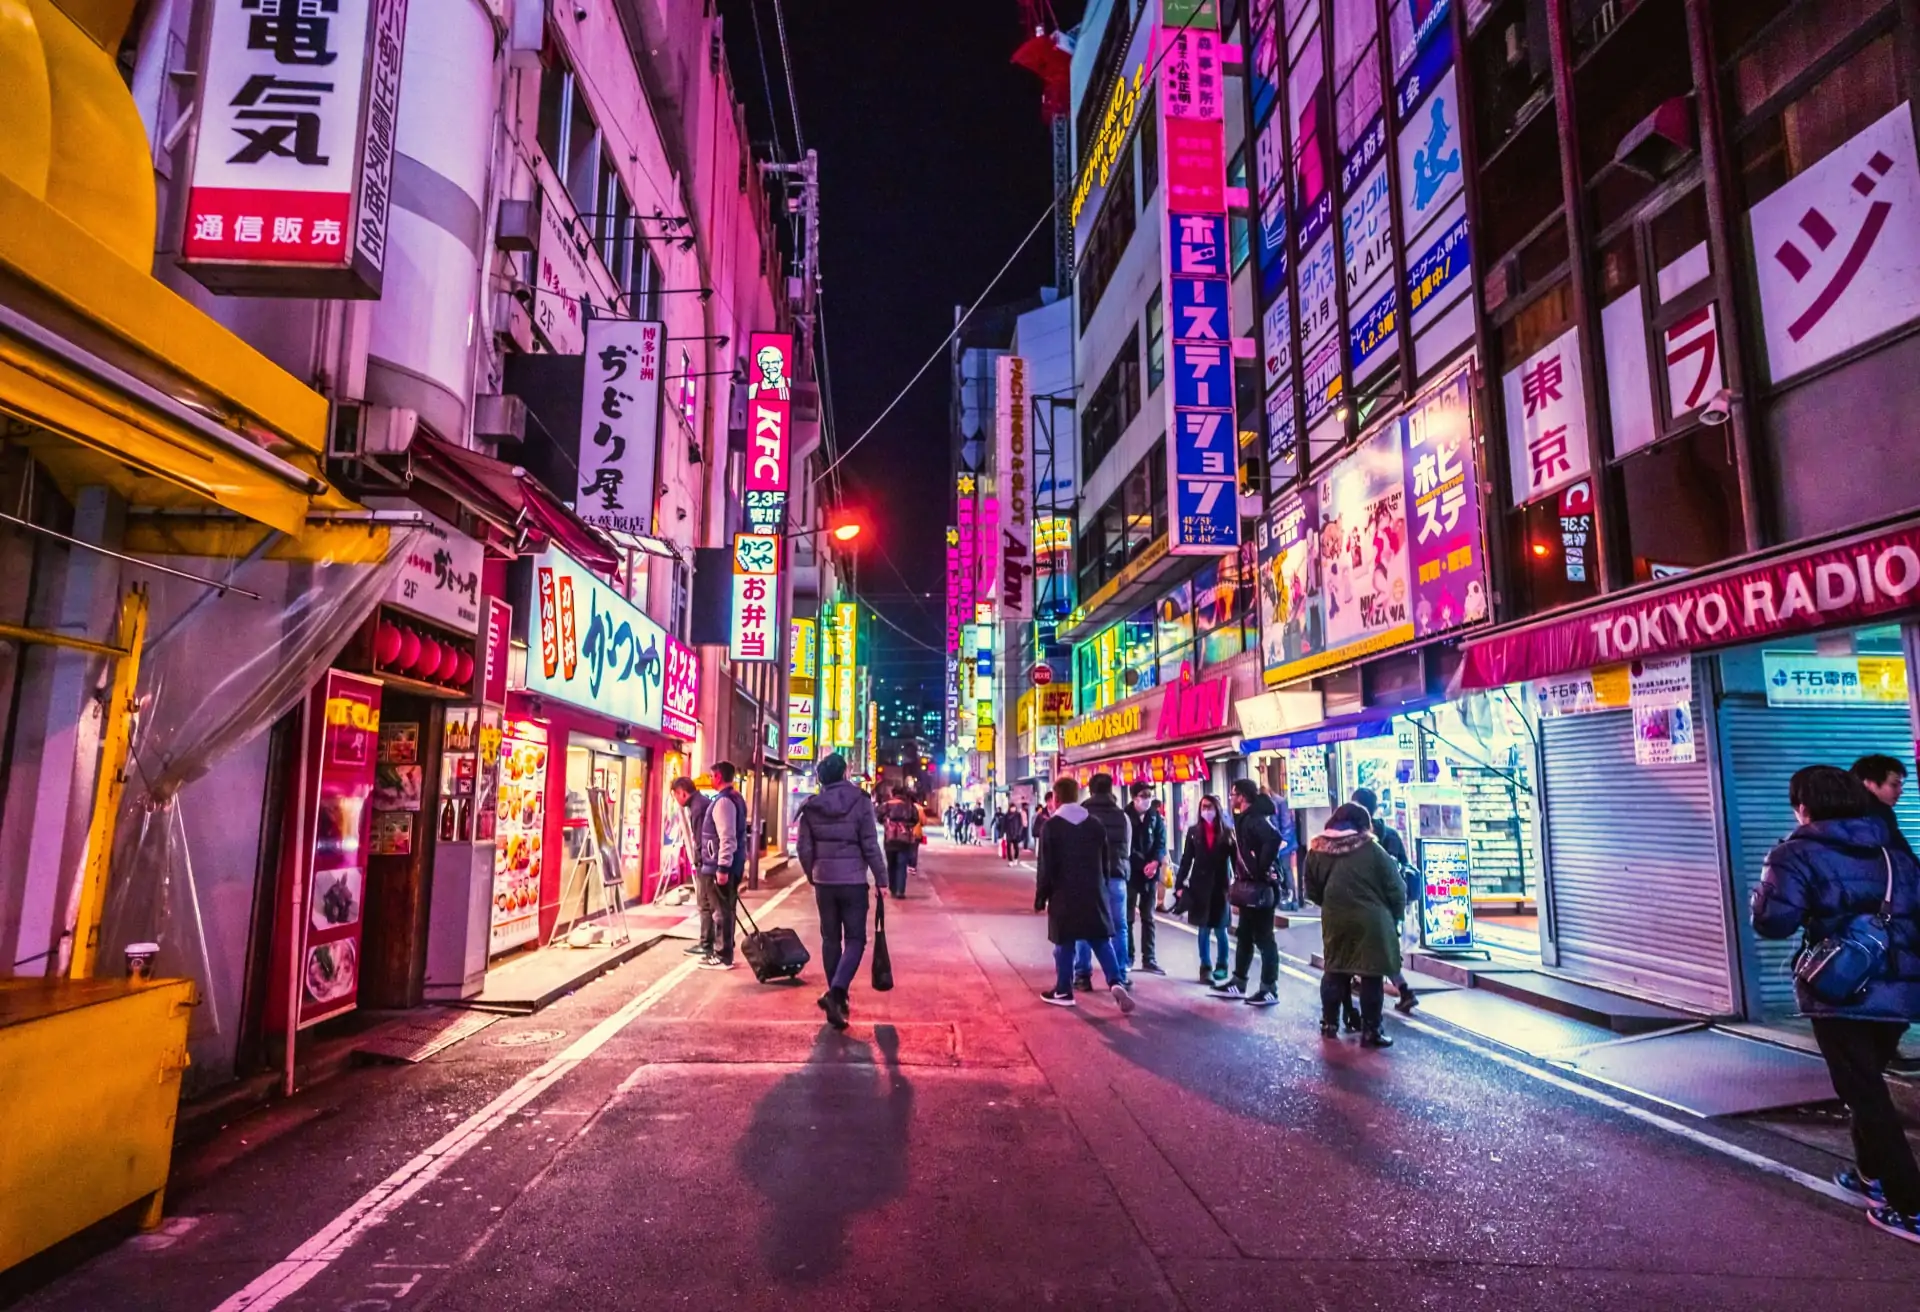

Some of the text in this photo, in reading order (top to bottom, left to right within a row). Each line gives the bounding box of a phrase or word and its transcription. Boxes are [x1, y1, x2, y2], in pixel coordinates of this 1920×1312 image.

[226, 0, 338, 166] 電気
[193, 213, 342, 245] 通信販売
[540, 299, 555, 336] 2F
[641, 328, 656, 381] 博多中洲
[1667, 305, 1716, 408] ラ
[581, 345, 640, 511] ぢどり屋
[754, 404, 781, 485] KFC
[1010, 358, 1031, 455] PACHINKO
[1522, 353, 1571, 486] 東京
[1011, 472, 1026, 527] SLOT
[1417, 486, 1467, 546] ステ
[404, 578, 419, 600] 2F
[538, 571, 557, 665] とんかつ
[561, 583, 575, 667] カツ丼
[740, 577, 766, 657] お弁当
[1591, 545, 1920, 659] TOKYO RADIO
[582, 587, 661, 716] かつや
[668, 641, 698, 690] カツ丼
[1790, 669, 1858, 687] 千石電商
[666, 675, 696, 716] とんかつ
[1064, 716, 1104, 749] PACHINKO
[1111, 705, 1141, 736] SLOT
